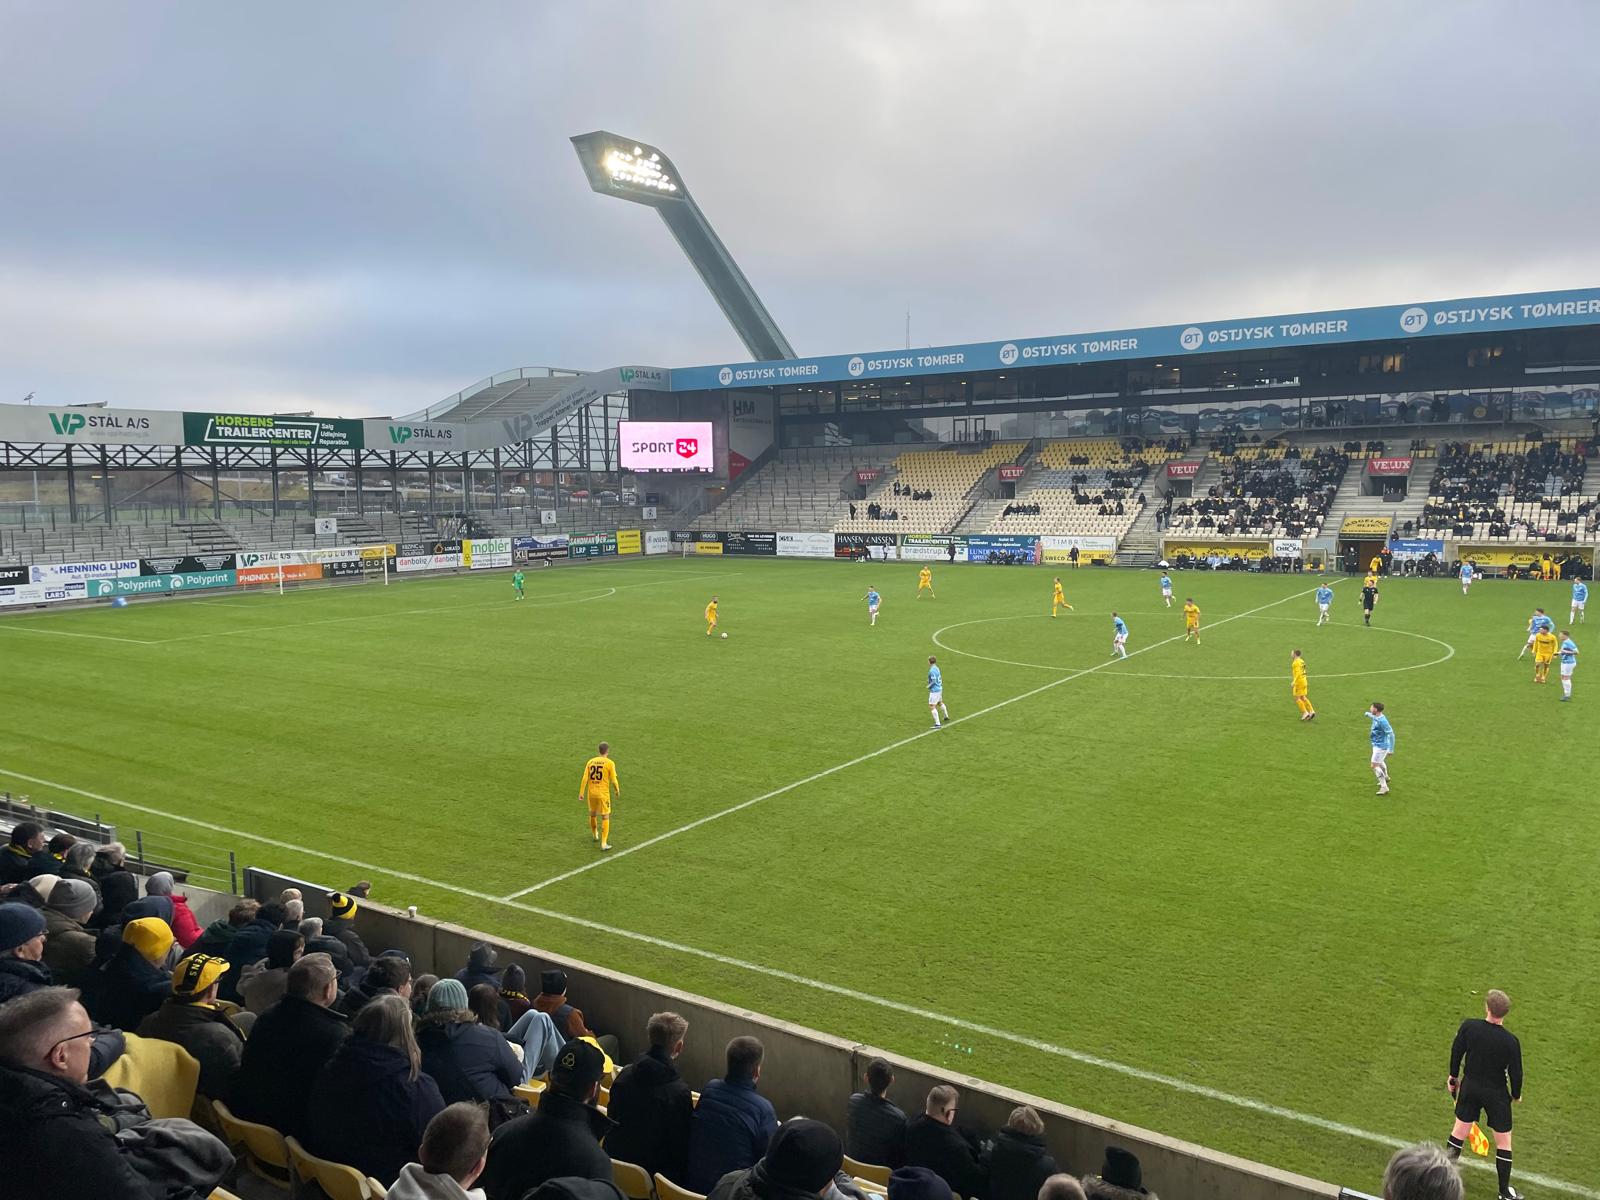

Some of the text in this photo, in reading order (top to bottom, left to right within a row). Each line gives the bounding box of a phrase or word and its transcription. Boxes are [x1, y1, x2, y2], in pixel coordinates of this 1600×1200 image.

[1434, 306, 1514, 325] ØSTJYSK
[1521, 299, 1600, 318] TØMRER
[1208, 326, 1274, 344] ØSTJYSK
[1280, 320, 1348, 337] TØMRER
[1022, 343, 1077, 359] ØSTJYSK
[1081, 338, 1138, 353] TØMRER
[867, 357, 913, 371] ØSTJYSK
[917, 353, 965, 367] TØMRER
[735, 368, 776, 381] ØSTJYSK
[778, 364, 819, 377] TØMRER
[48, 412, 150, 435] VP STÅL A/S
[215, 415, 274, 427] HORSENS
[321, 423, 334, 431] Salg
[217, 427, 312, 439] TRAILERCENTER
[320, 431, 347, 439] Udlejning
[389, 425, 412, 444] VP
[413, 425, 435, 439] STÅL
[437, 429, 452, 439] A/S
[319, 438, 349, 446] Reparation
[632, 441, 697, 454] SPORT 24
[1373, 460, 1411, 470] VELUX
[837, 534, 864, 544] HANSEN
[871, 535, 894, 544] NISSEN
[240, 553, 259, 567] VP
[60, 561, 137, 574] HENNING LUND
[117, 579, 162, 592] Polyprint
[187, 573, 228, 585] Polyprint
[46, 591, 65, 599] LARS
[590, 765, 603, 781] 25
